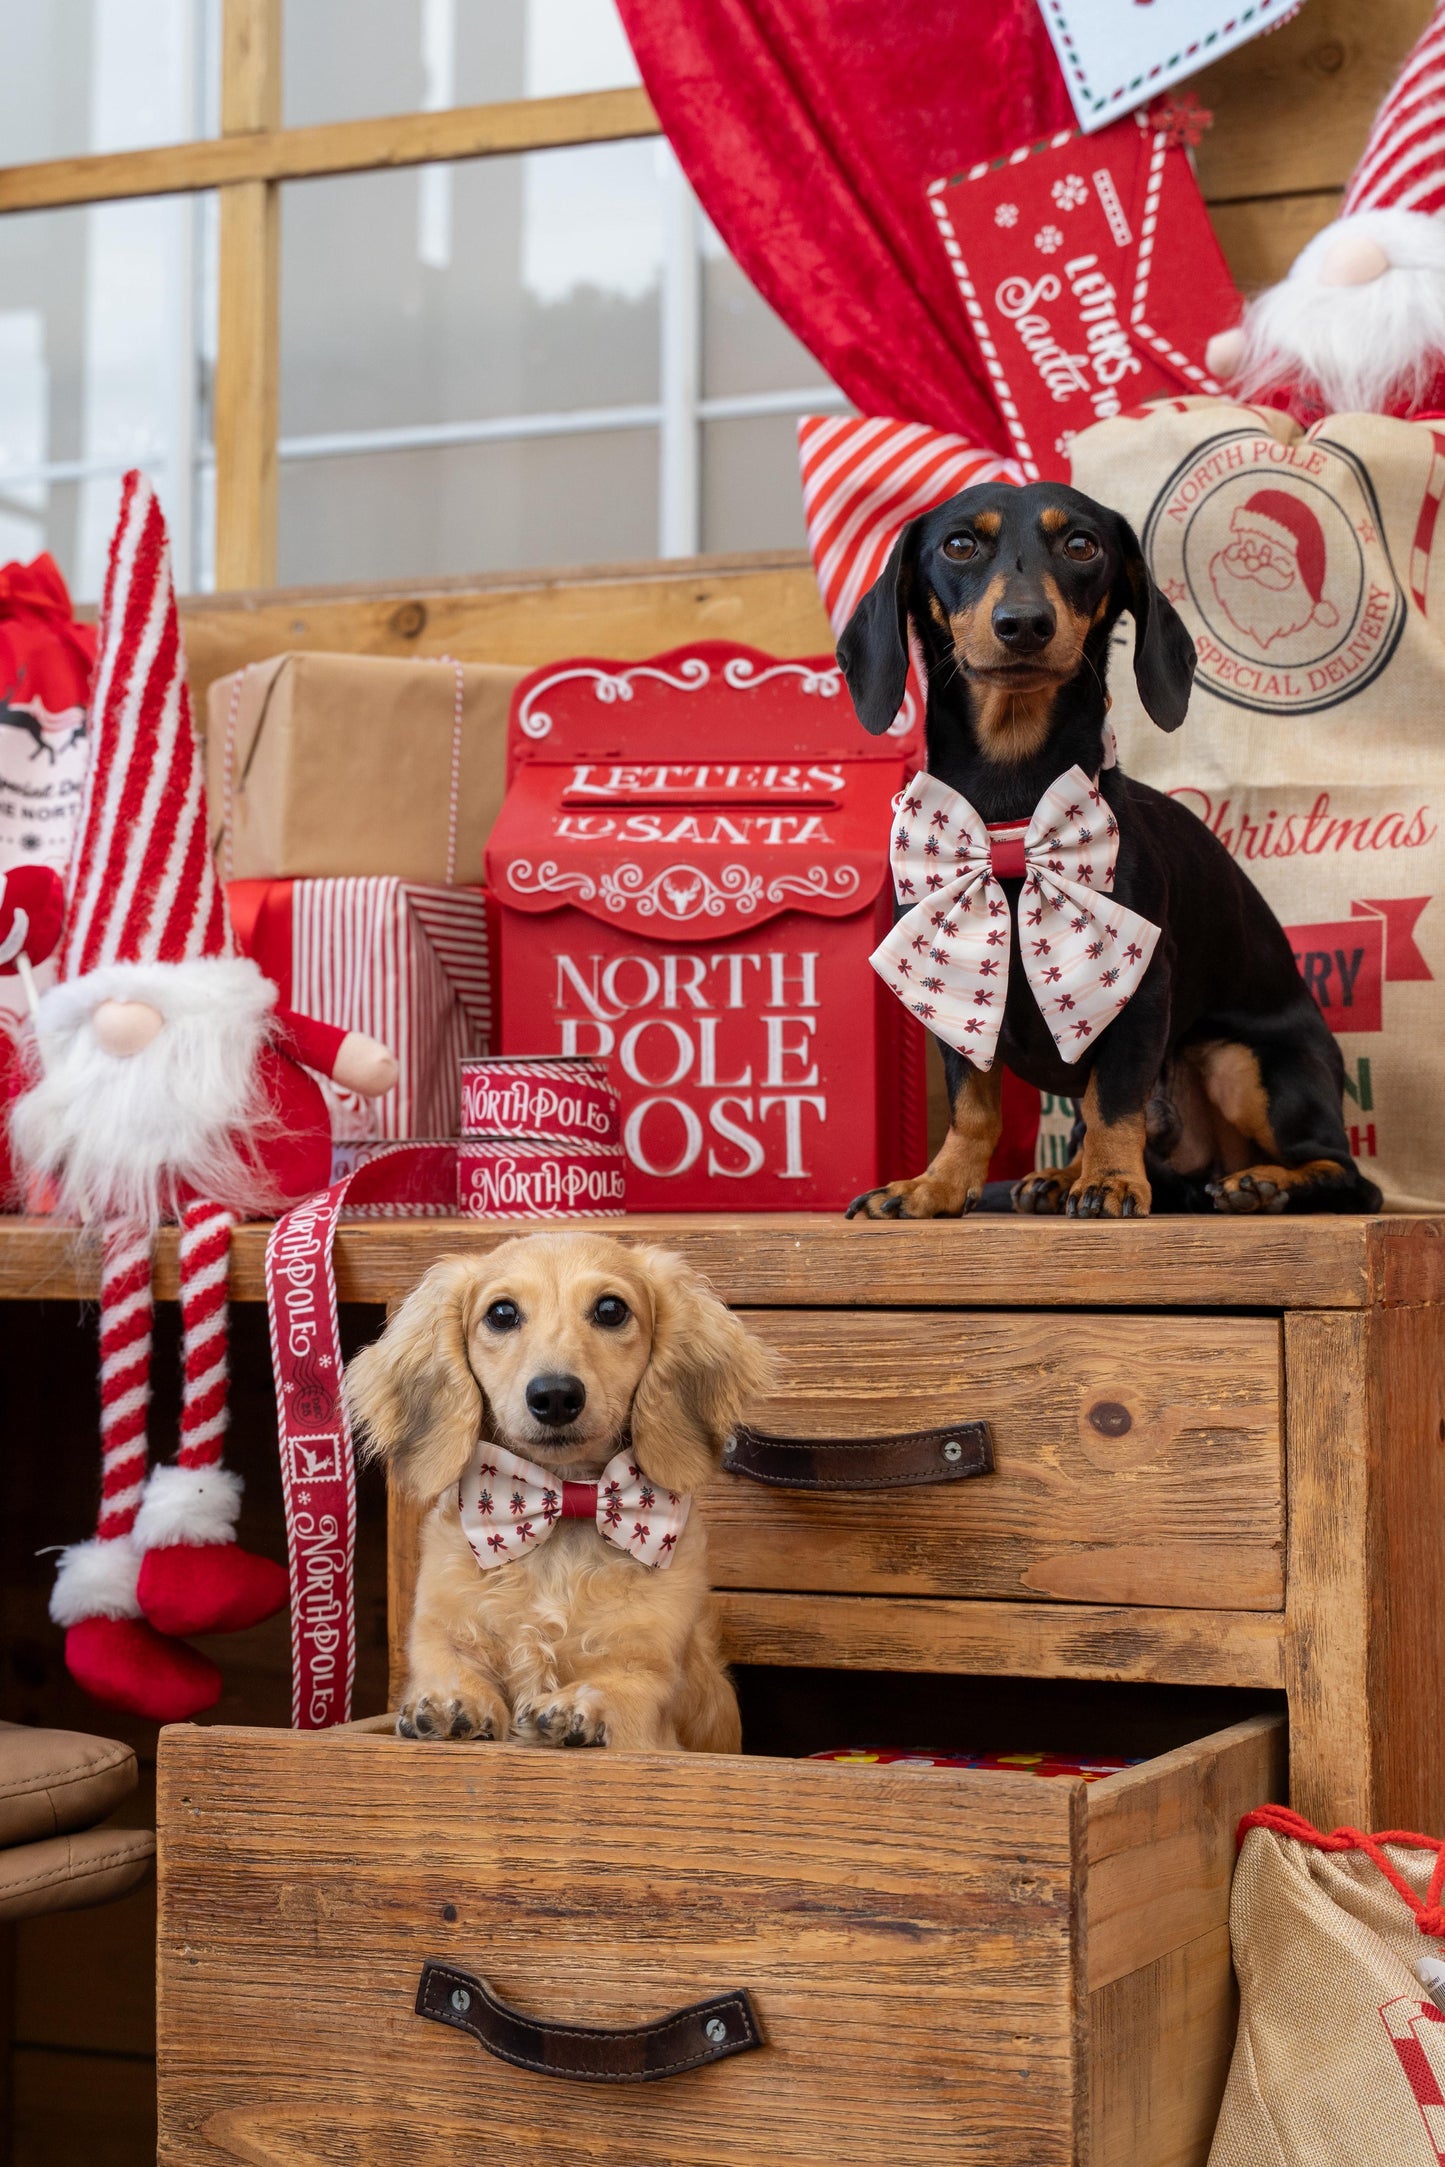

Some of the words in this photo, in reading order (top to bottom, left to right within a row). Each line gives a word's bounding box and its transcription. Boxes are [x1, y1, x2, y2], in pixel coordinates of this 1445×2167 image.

[995, 273, 1092, 402] Santa
[1064, 254, 1142, 384] LETTERS
[1167, 445, 1247, 523] NORTH
[1252, 441, 1327, 476] POLE
[1195, 635, 1301, 697] SPECIAL
[1308, 583, 1391, 692] DELIVERY
[562, 765, 846, 796] LETTERS
[616, 815, 836, 845] SANTA
[553, 952, 821, 1021] NORTH
[554, 1015, 820, 1088] POLE
[461, 1075, 530, 1132] NORTH
[529, 1087, 610, 1134] POLE
[623, 1095, 827, 1179] OST
[272, 1191, 334, 1259] NORTH
[469, 1158, 561, 1213] NORTH
[561, 1165, 625, 1206] POLE
[276, 1257, 317, 1358] POLE
[294, 1511, 346, 1624] NORTH
[303, 1622, 340, 1724] POLE
